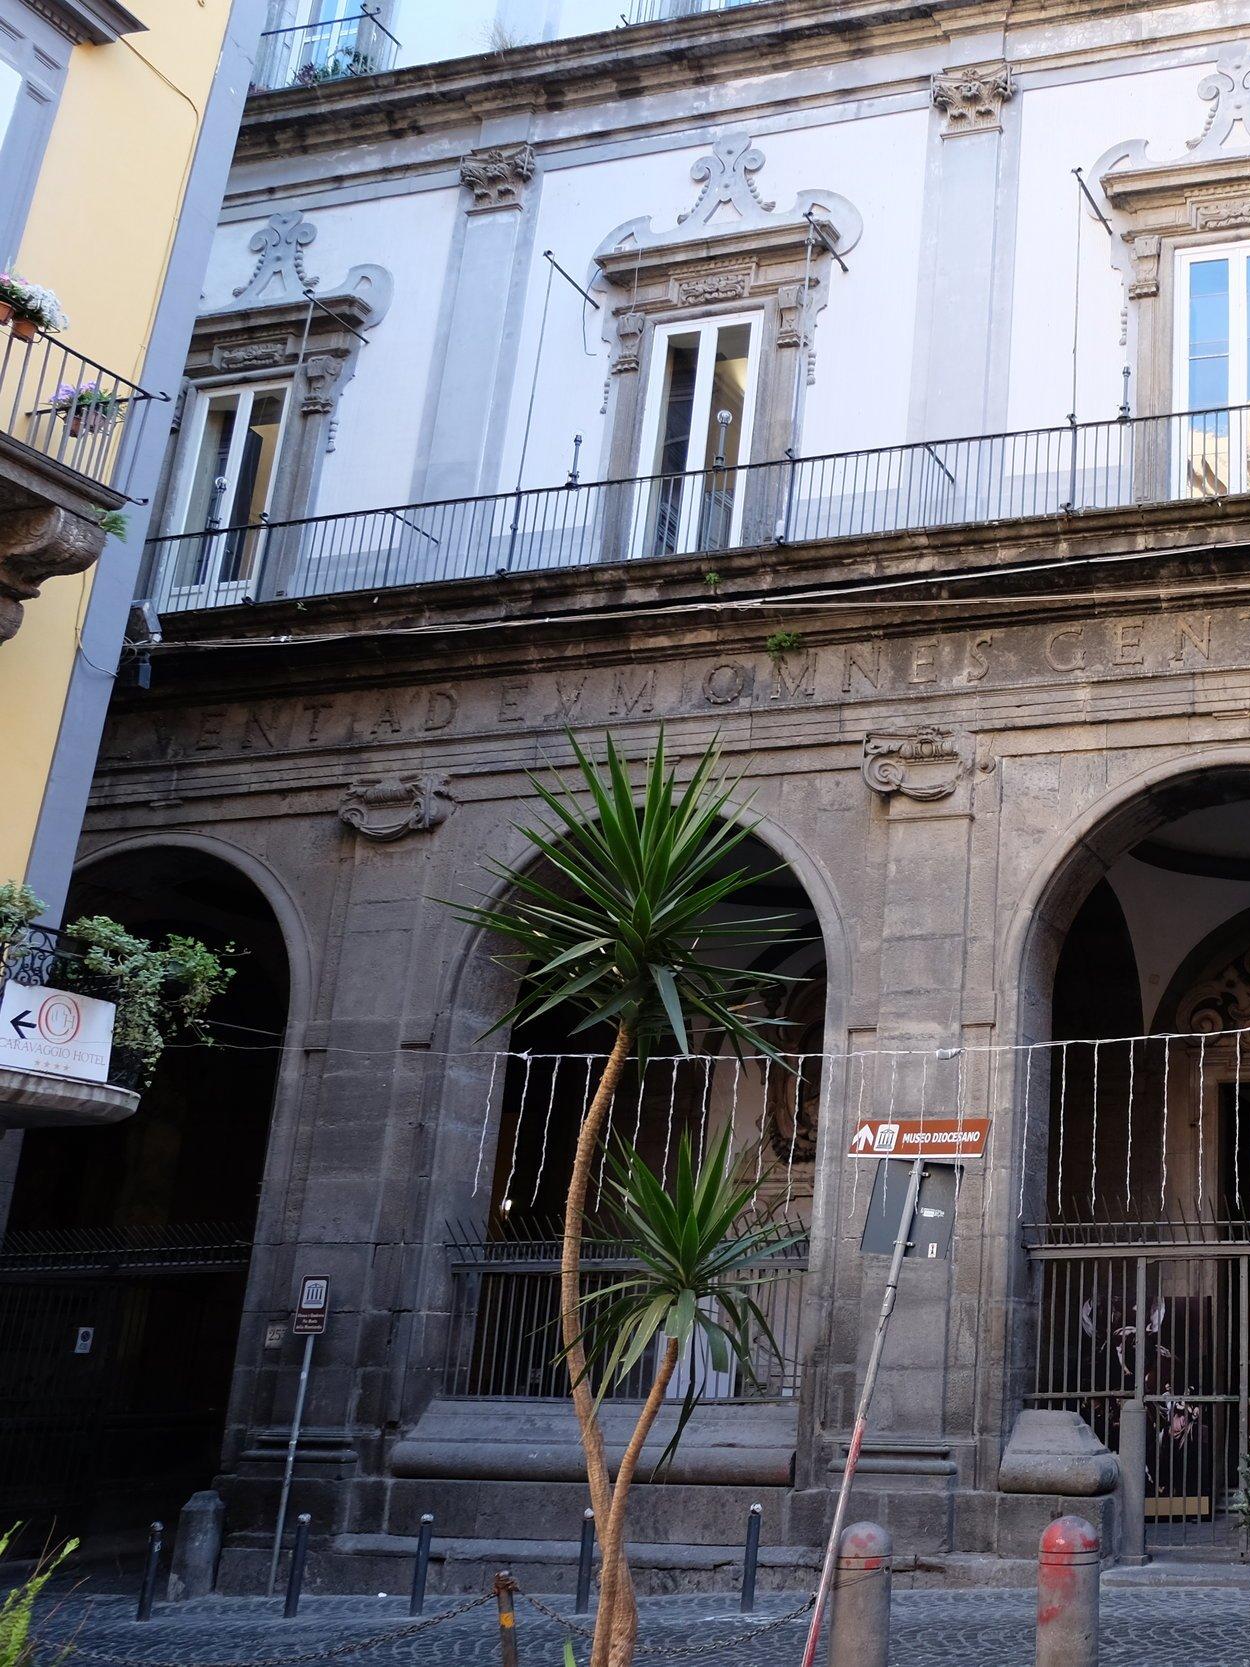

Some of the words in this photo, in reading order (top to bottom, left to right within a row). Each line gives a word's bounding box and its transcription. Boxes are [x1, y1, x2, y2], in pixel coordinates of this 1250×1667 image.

[371, 689, 459, 734] AD
[702, 634, 993, 705] OMNES
[0, 1037, 70, 1059] CARAVAGGIO
[73, 1050, 106, 1066] HOTEL
[902, 1132, 931, 1144] MUSEO
[931, 1131, 981, 1143] DIOCESANO
